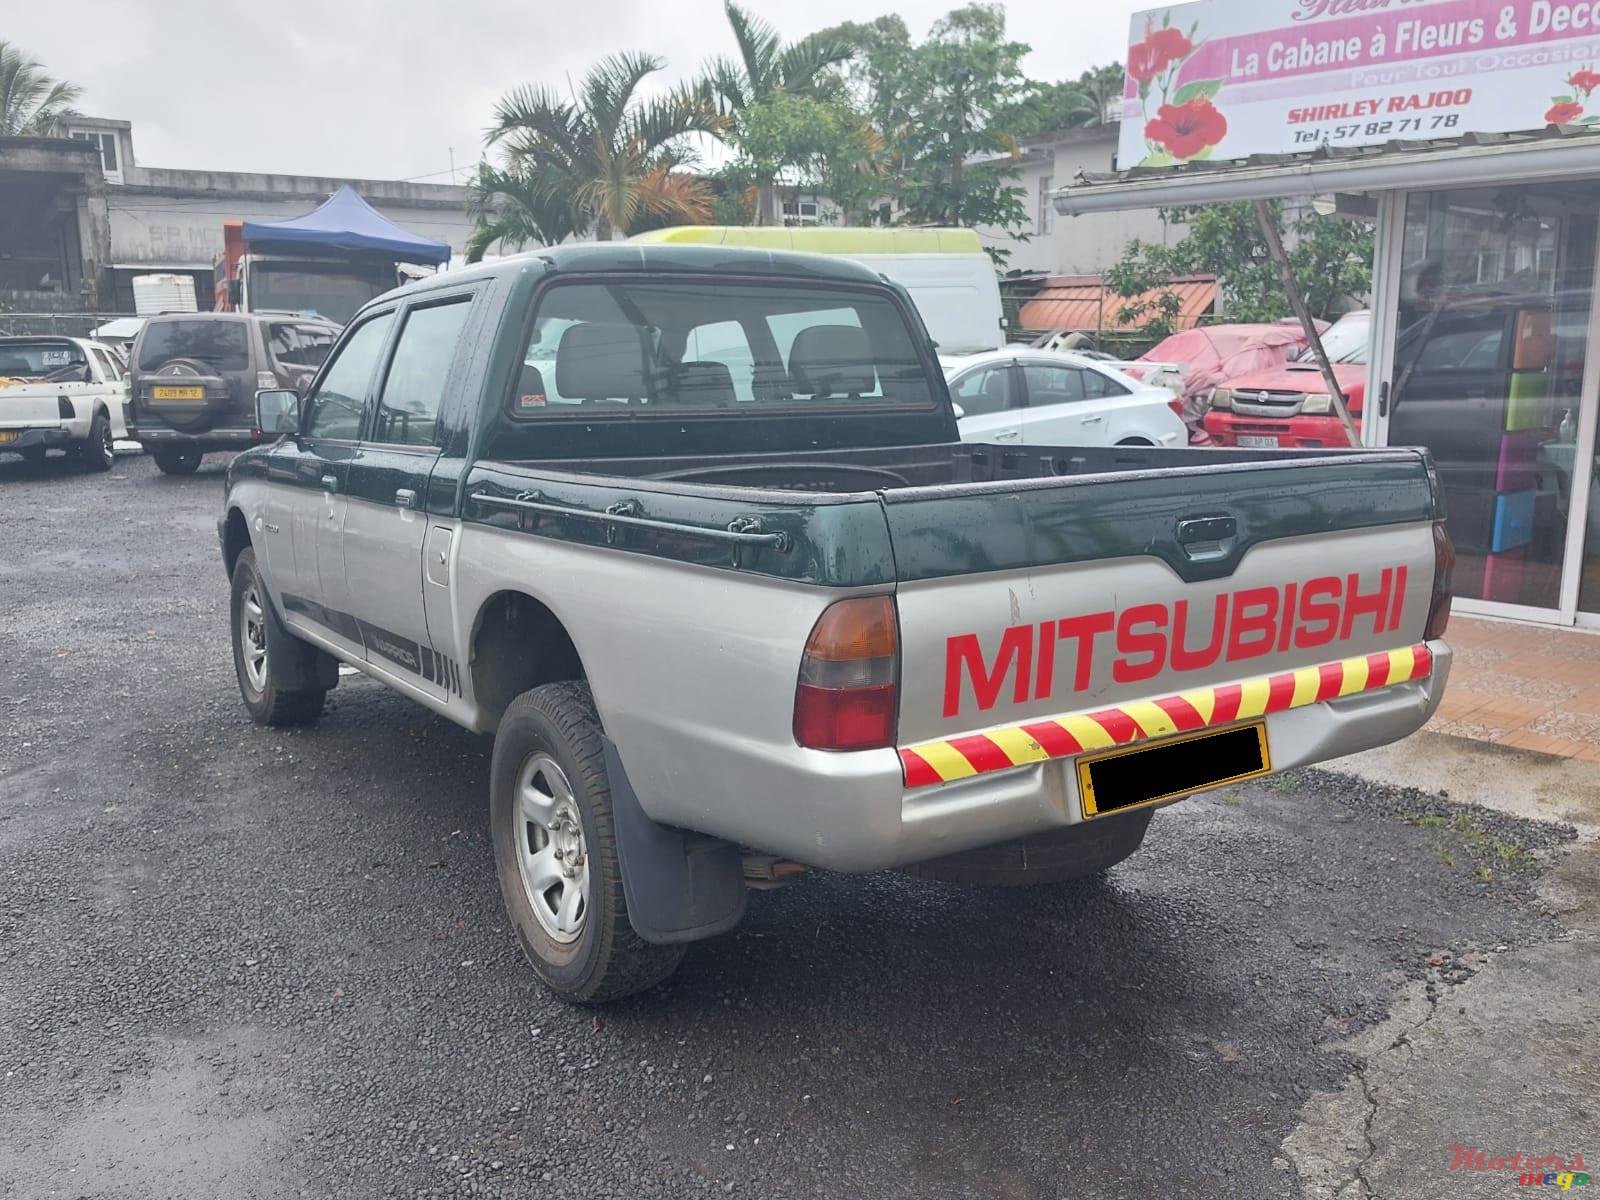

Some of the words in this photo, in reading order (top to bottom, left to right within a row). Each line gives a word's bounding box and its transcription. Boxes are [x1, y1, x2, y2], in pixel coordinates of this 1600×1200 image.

[1230, 48, 1259, 77] La
[1267, 36, 1362, 72] Cabane
[1369, 25, 1387, 58] à
[1395, 18, 1485, 54] Fleurs
[1495, 5, 1518, 40] &
[1351, 69, 1405, 88] Pour
[1416, 61, 1464, 79] Tout
[1287, 98, 1384, 125] SHIRLEY
[1387, 88, 1473, 113] RAJOO
[1333, 124, 1361, 140] 57
[1364, 121, 1394, 136] 82
[1398, 117, 1422, 132] 71
[1430, 113, 1460, 130] 78
[942, 565, 1408, 718] MITSUBISHI
